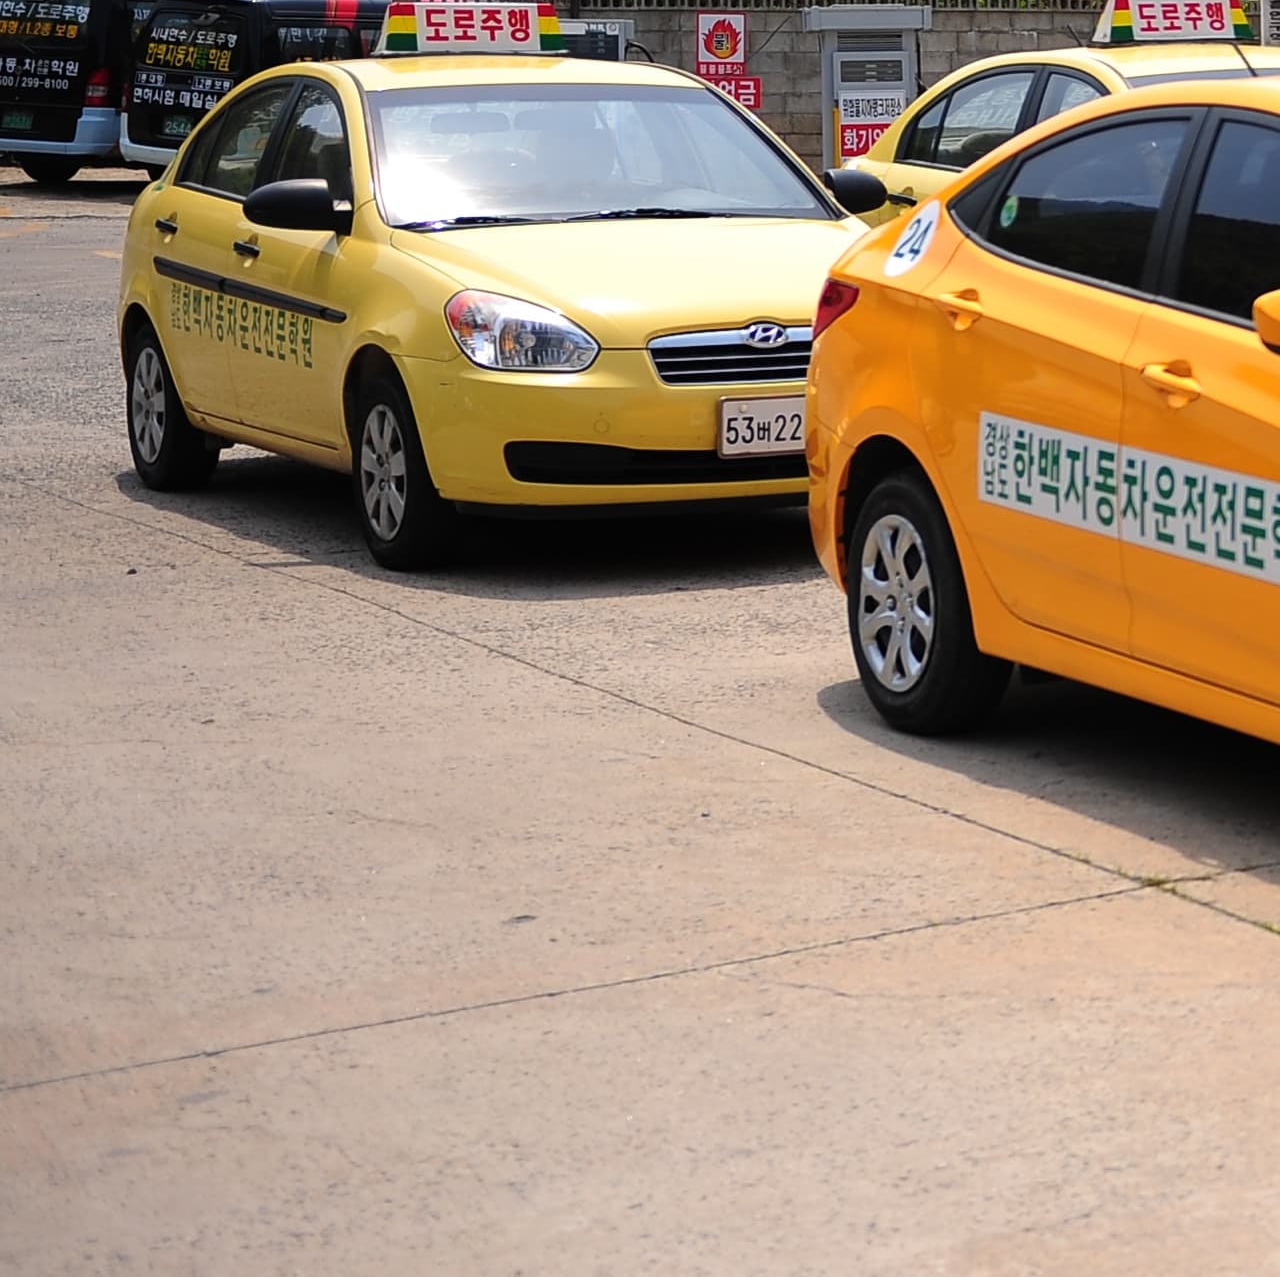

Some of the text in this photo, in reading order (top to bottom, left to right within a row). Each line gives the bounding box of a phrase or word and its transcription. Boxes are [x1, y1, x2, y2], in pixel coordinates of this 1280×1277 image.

[425, 8, 531, 42] 도로주행
[1137, 1, 1226, 33] 도로주행
[711, 79, 757, 106] 엄금
[892, 216, 934, 262] 24
